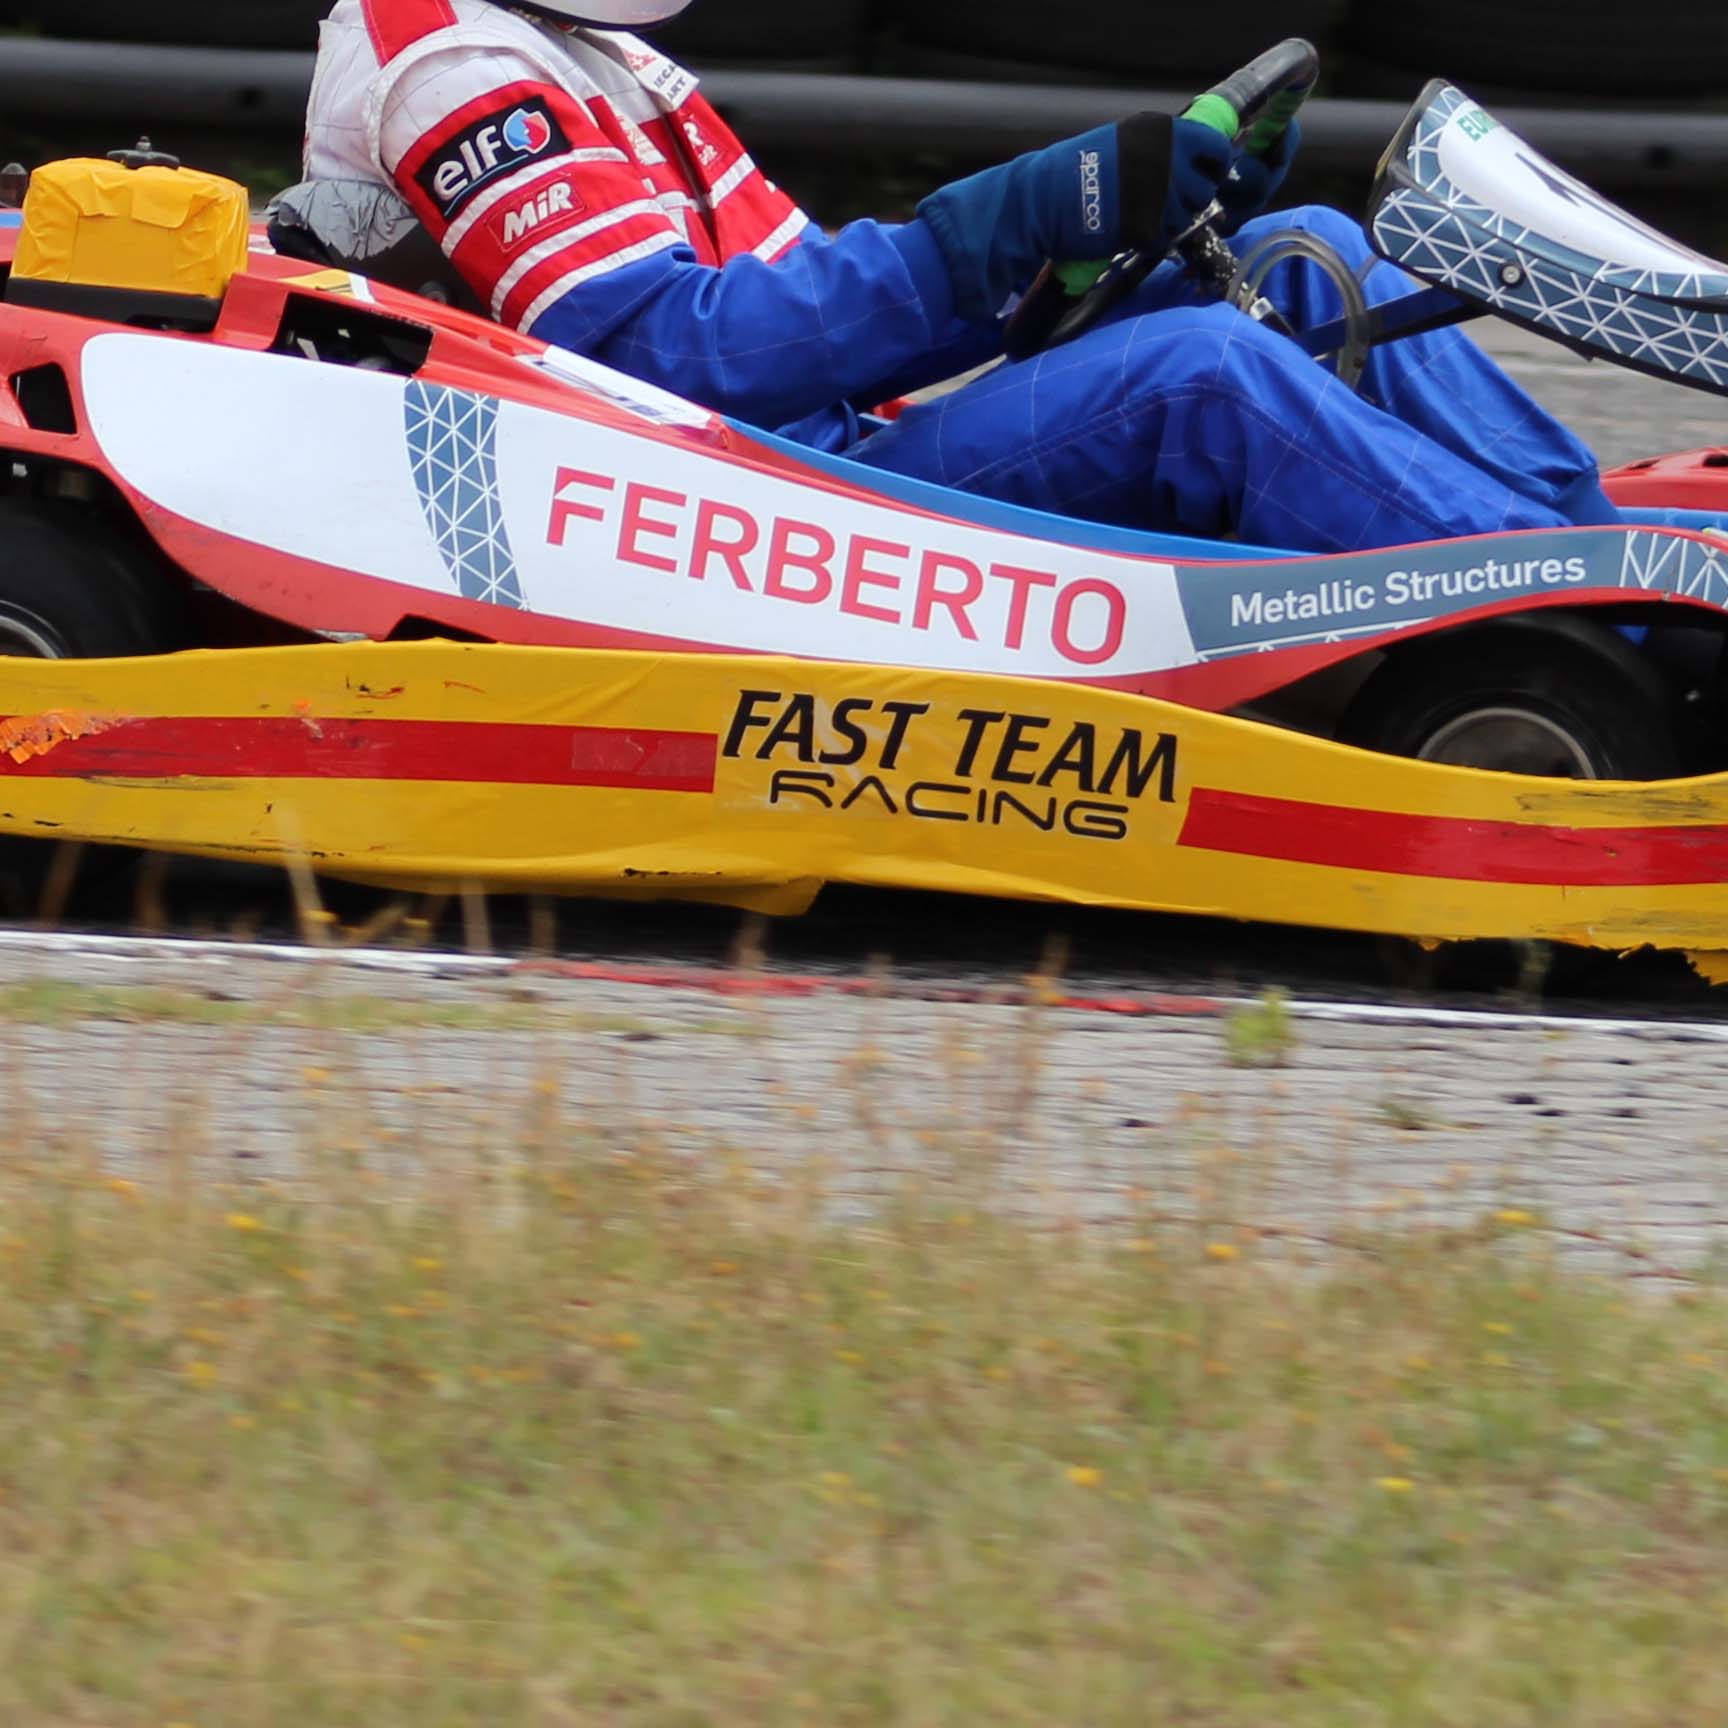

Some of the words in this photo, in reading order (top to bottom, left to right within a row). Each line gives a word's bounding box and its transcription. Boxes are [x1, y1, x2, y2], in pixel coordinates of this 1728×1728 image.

[434, 124, 502, 201] elf
[544, 466, 1126, 665] FERBERTO
[1231, 582, 1376, 629] Metallic
[1383, 553, 1587, 608] Structures
[722, 688, 930, 774] FAST
[952, 707, 1178, 805] TEAM
[769, 769, 1130, 841] RACING
